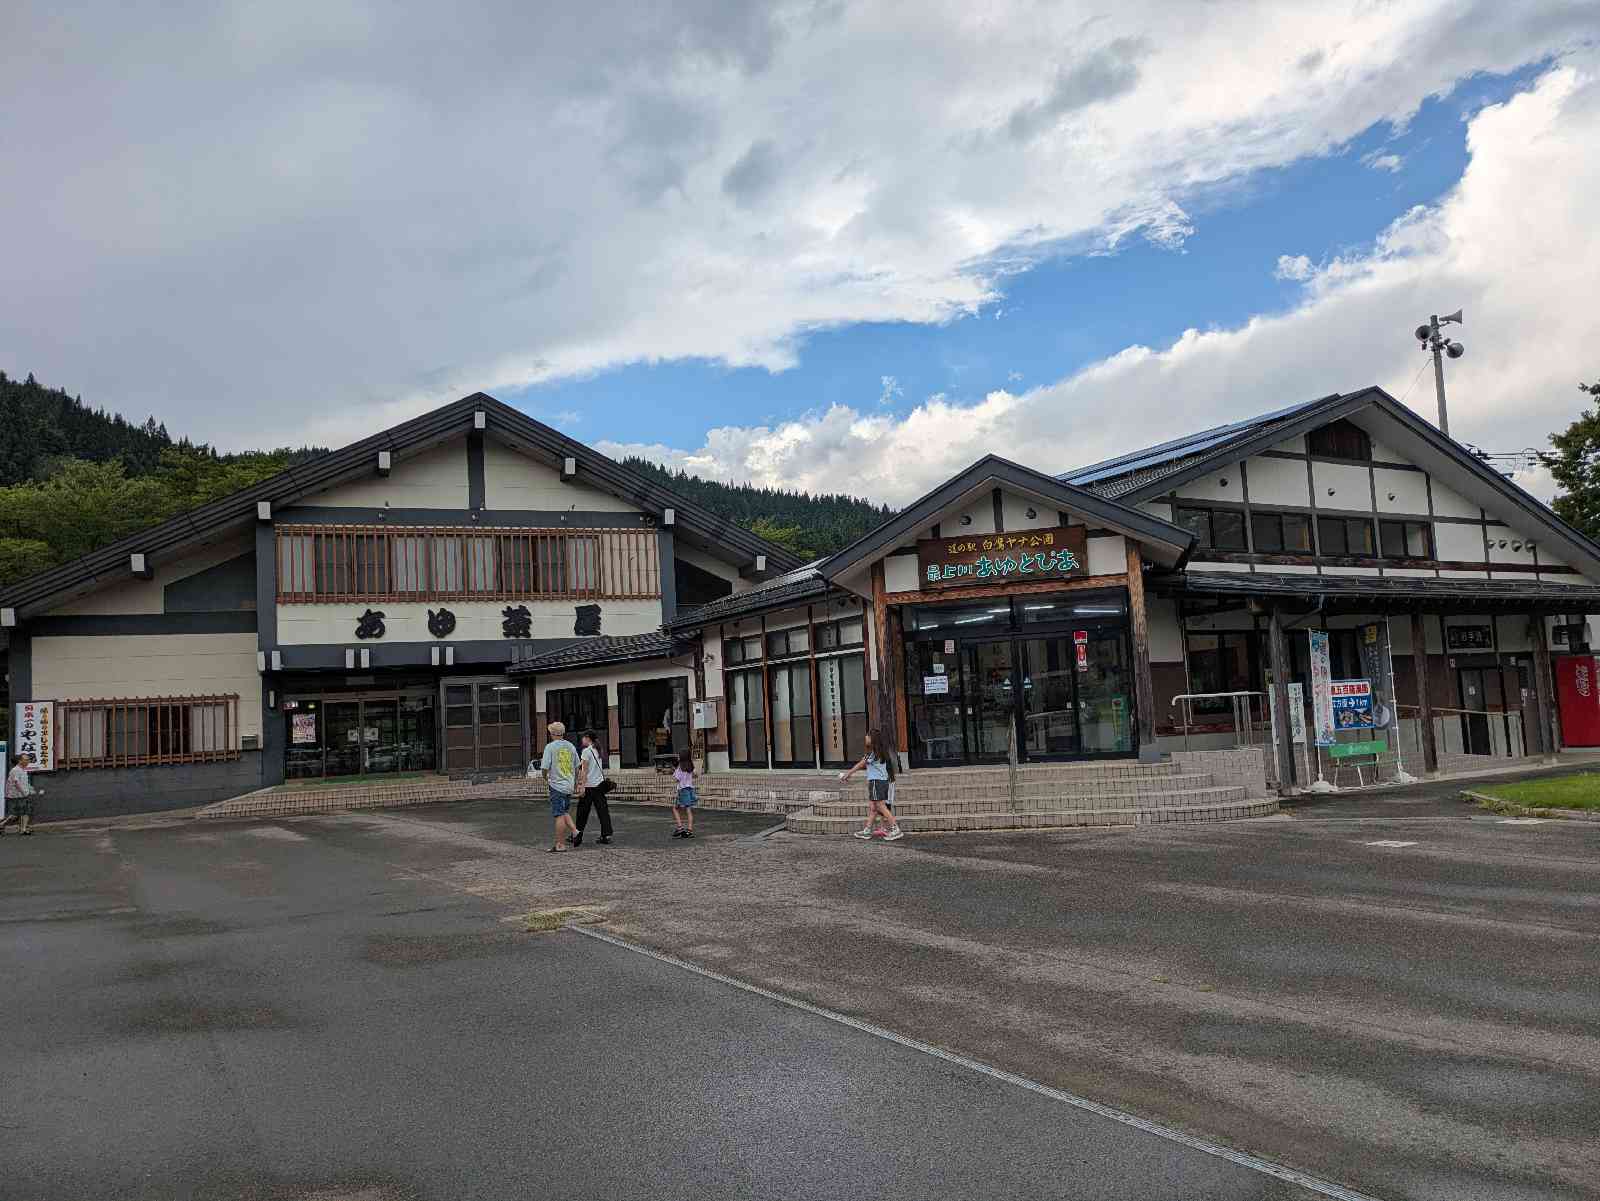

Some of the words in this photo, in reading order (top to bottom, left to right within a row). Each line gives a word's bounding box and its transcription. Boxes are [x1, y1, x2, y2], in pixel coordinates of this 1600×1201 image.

[948, 543, 977, 554] 道の駅
[982, 533, 1054, 551] 白鷹ヤナ公園
[927, 564, 973, 582] 最上川
[975, 549, 1080, 578] あゆとぴあ
[355, 604, 602, 640] あゆ茶屋
